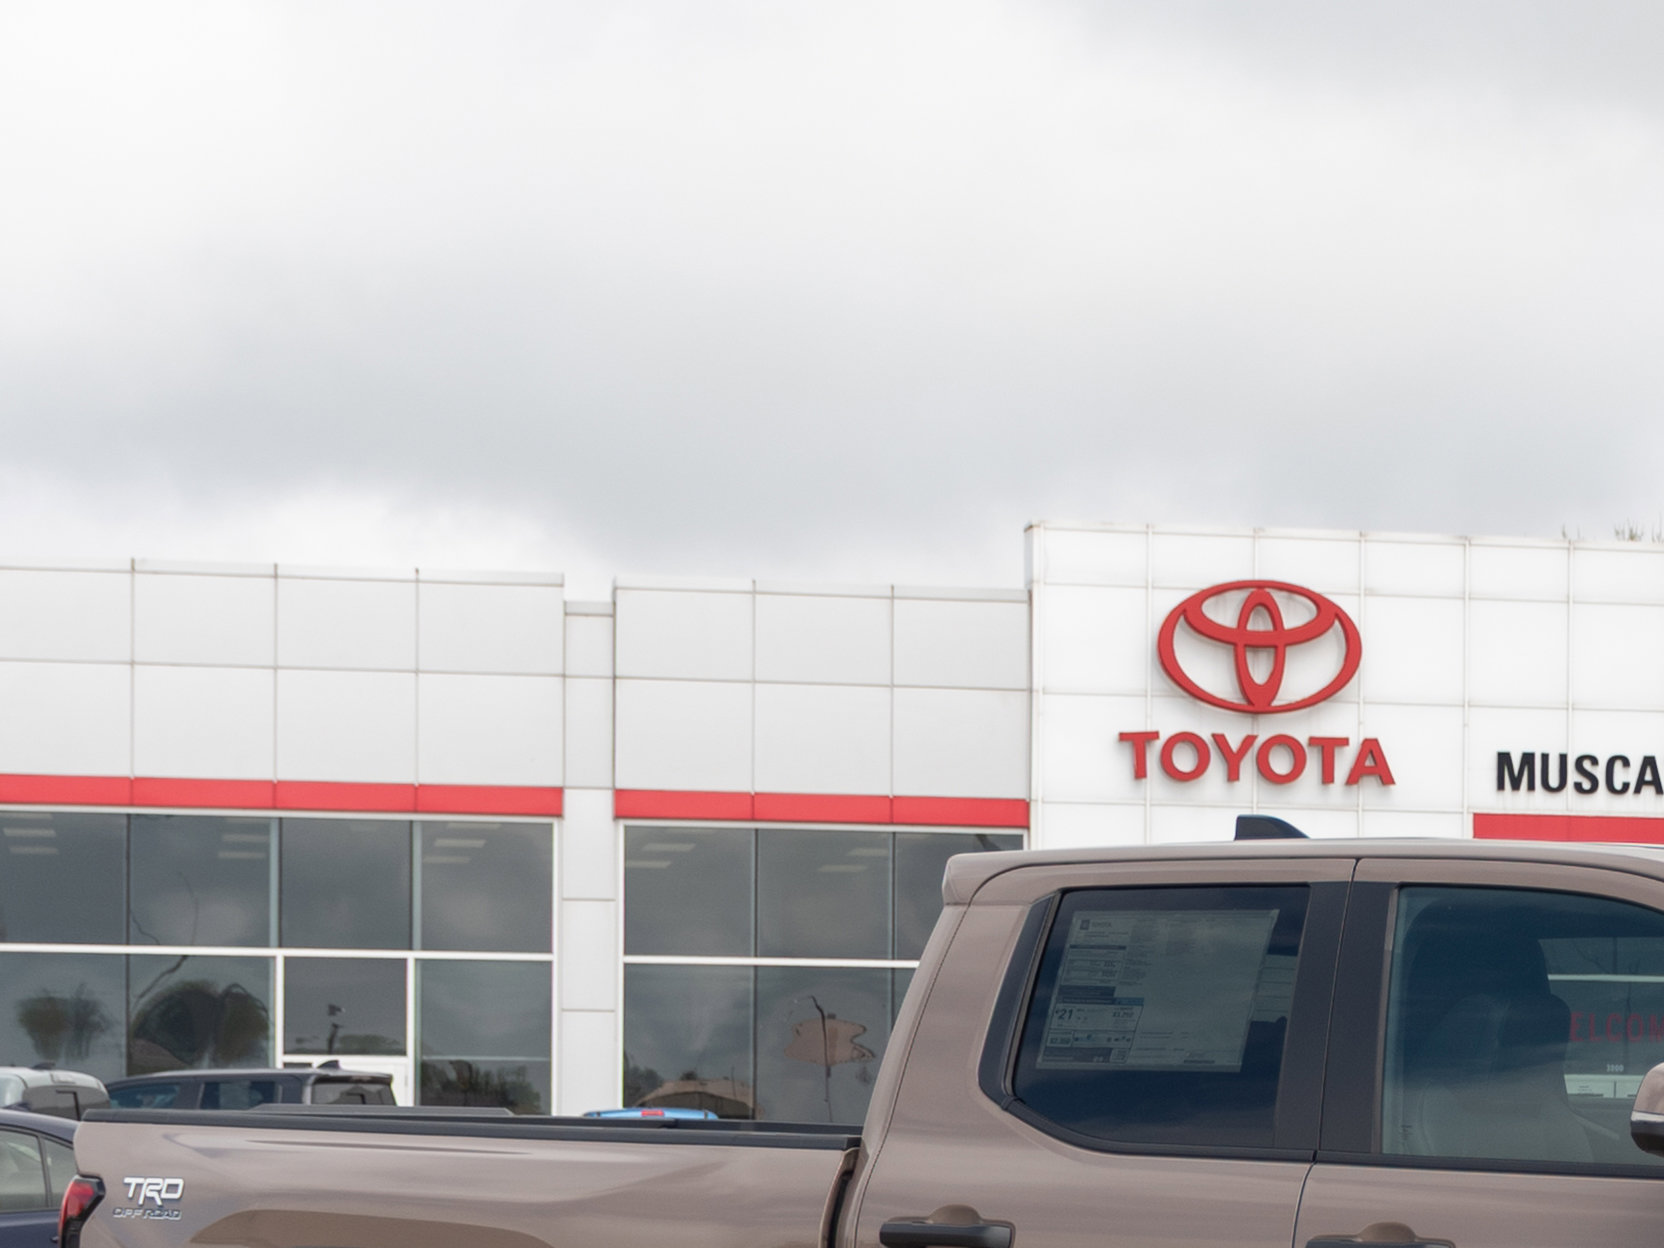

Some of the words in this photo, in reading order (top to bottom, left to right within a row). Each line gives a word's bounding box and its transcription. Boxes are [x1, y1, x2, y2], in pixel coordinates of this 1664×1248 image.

[1117, 731, 1396, 787] TOYOTA
[1057, 1008, 1074, 1021] 21
[123, 1176, 184, 1206] TRD
